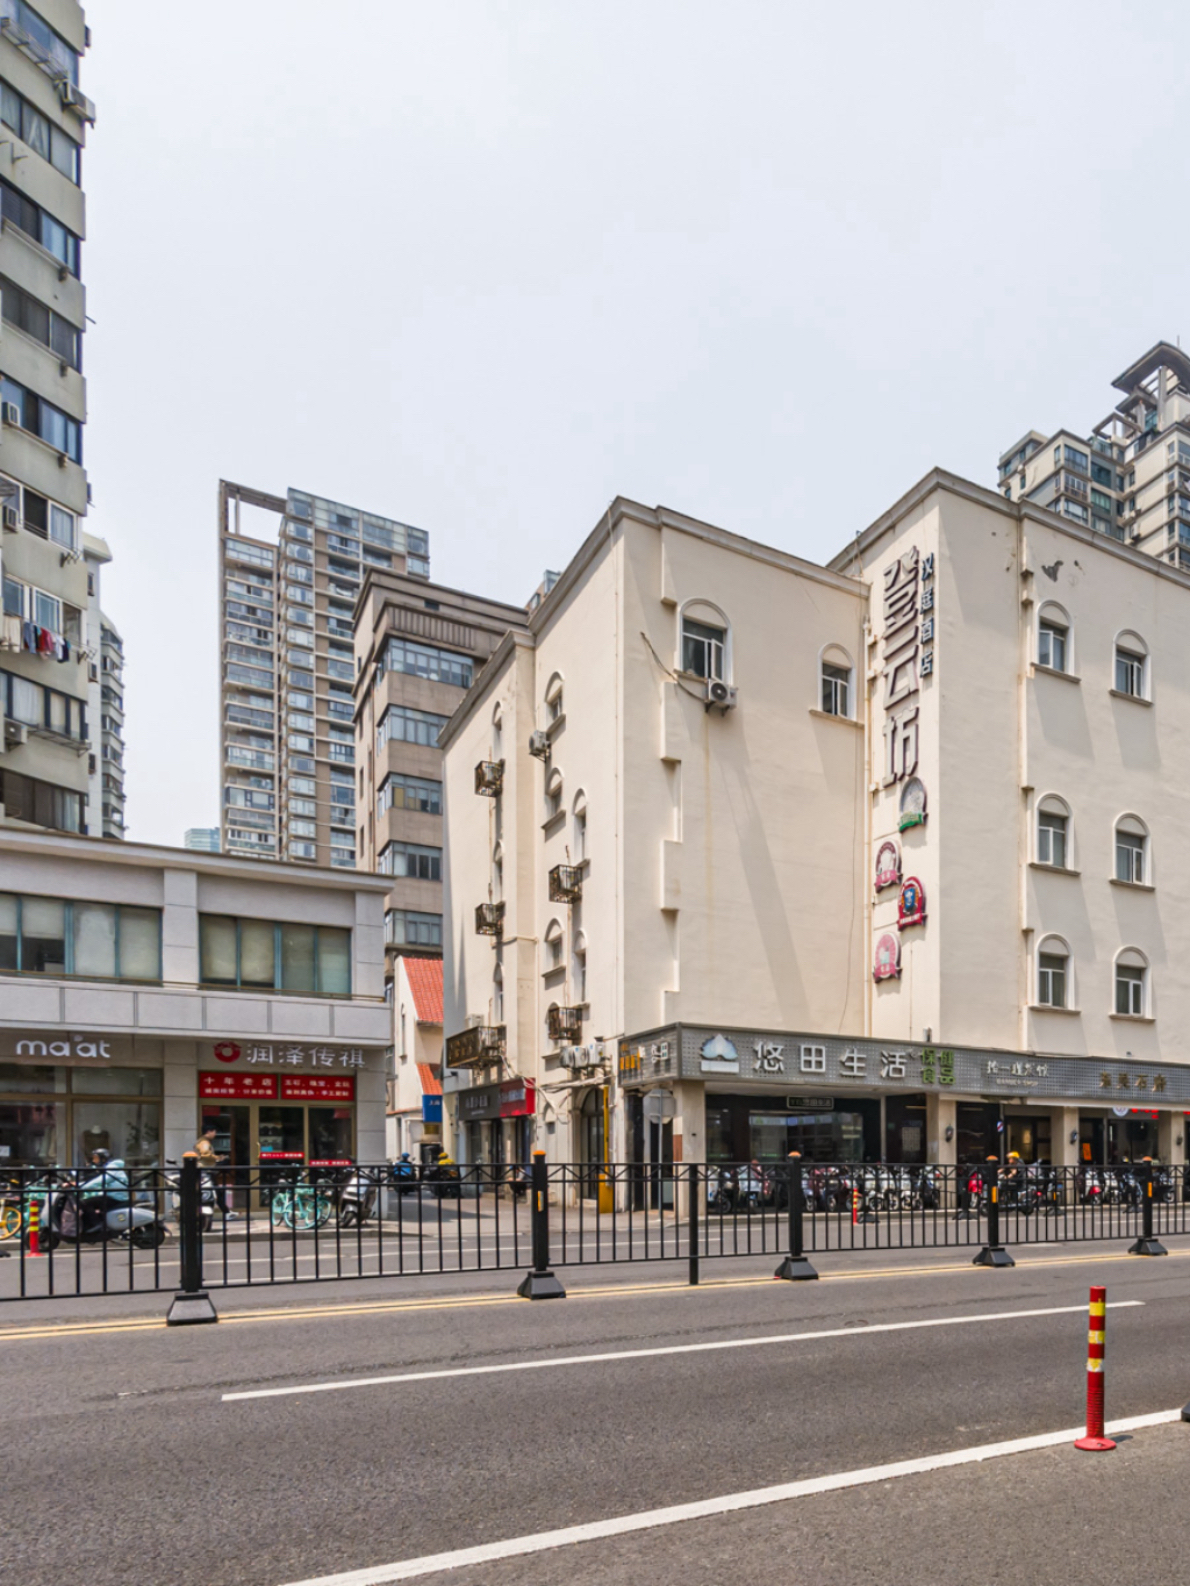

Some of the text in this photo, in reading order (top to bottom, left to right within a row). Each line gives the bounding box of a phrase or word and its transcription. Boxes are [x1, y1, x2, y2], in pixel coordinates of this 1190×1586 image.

[919, 551, 935, 680] 汉庭酒店
[882, 545, 920, 790] 登云坊
[246, 1043, 366, 1068] 润泽传祺
[753, 1040, 908, 1079] 悠田生活
